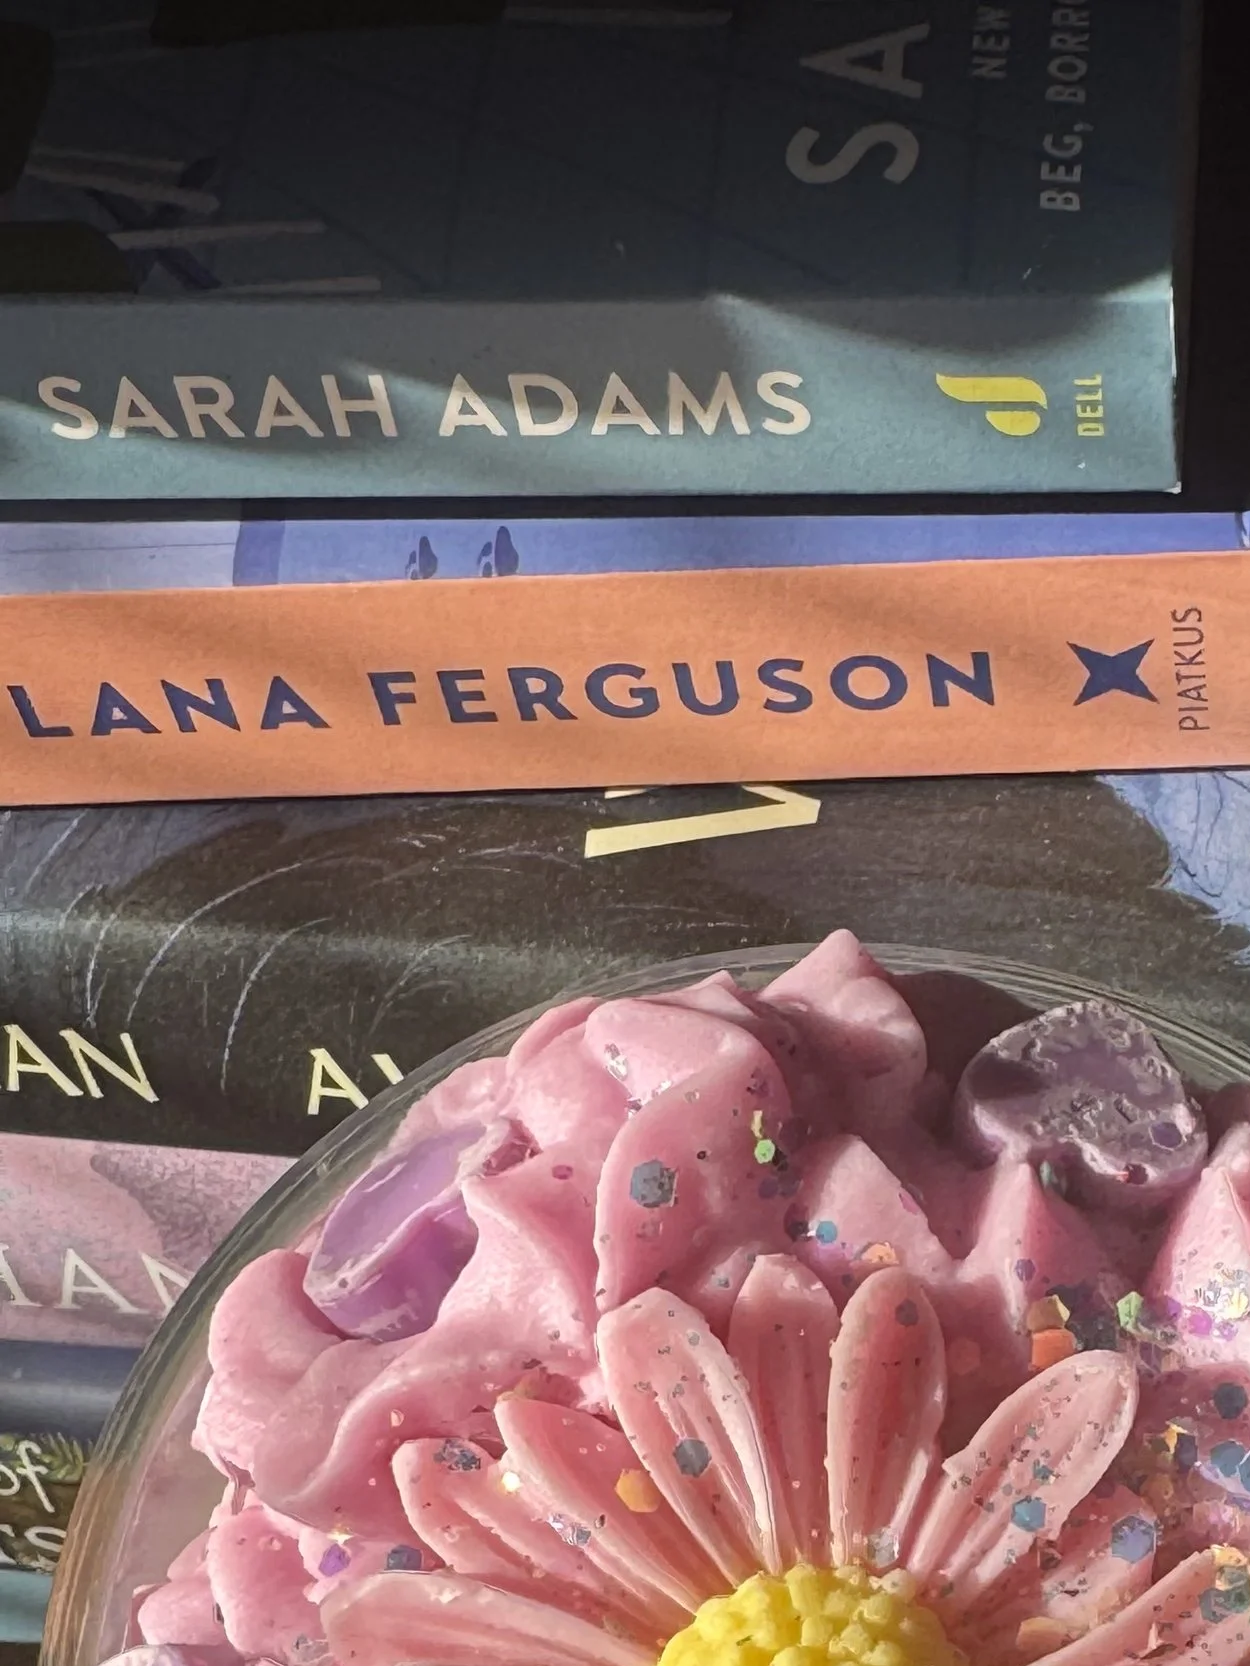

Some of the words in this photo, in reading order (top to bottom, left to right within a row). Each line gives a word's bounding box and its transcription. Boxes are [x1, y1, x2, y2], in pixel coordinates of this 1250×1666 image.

[967, 4, 1011, 80] NEW
[1044, 0, 1092, 104] BORR
[1040, 121, 1095, 212] BEG,
[37, 373, 398, 440] SARAH
[438, 370, 812, 437] ADAMS
[1076, 373, 1105, 437] DELL
[7, 675, 332, 738] LANA
[367, 651, 995, 727] FERGUSON
[1170, 606, 1210, 731] PIATKUS
